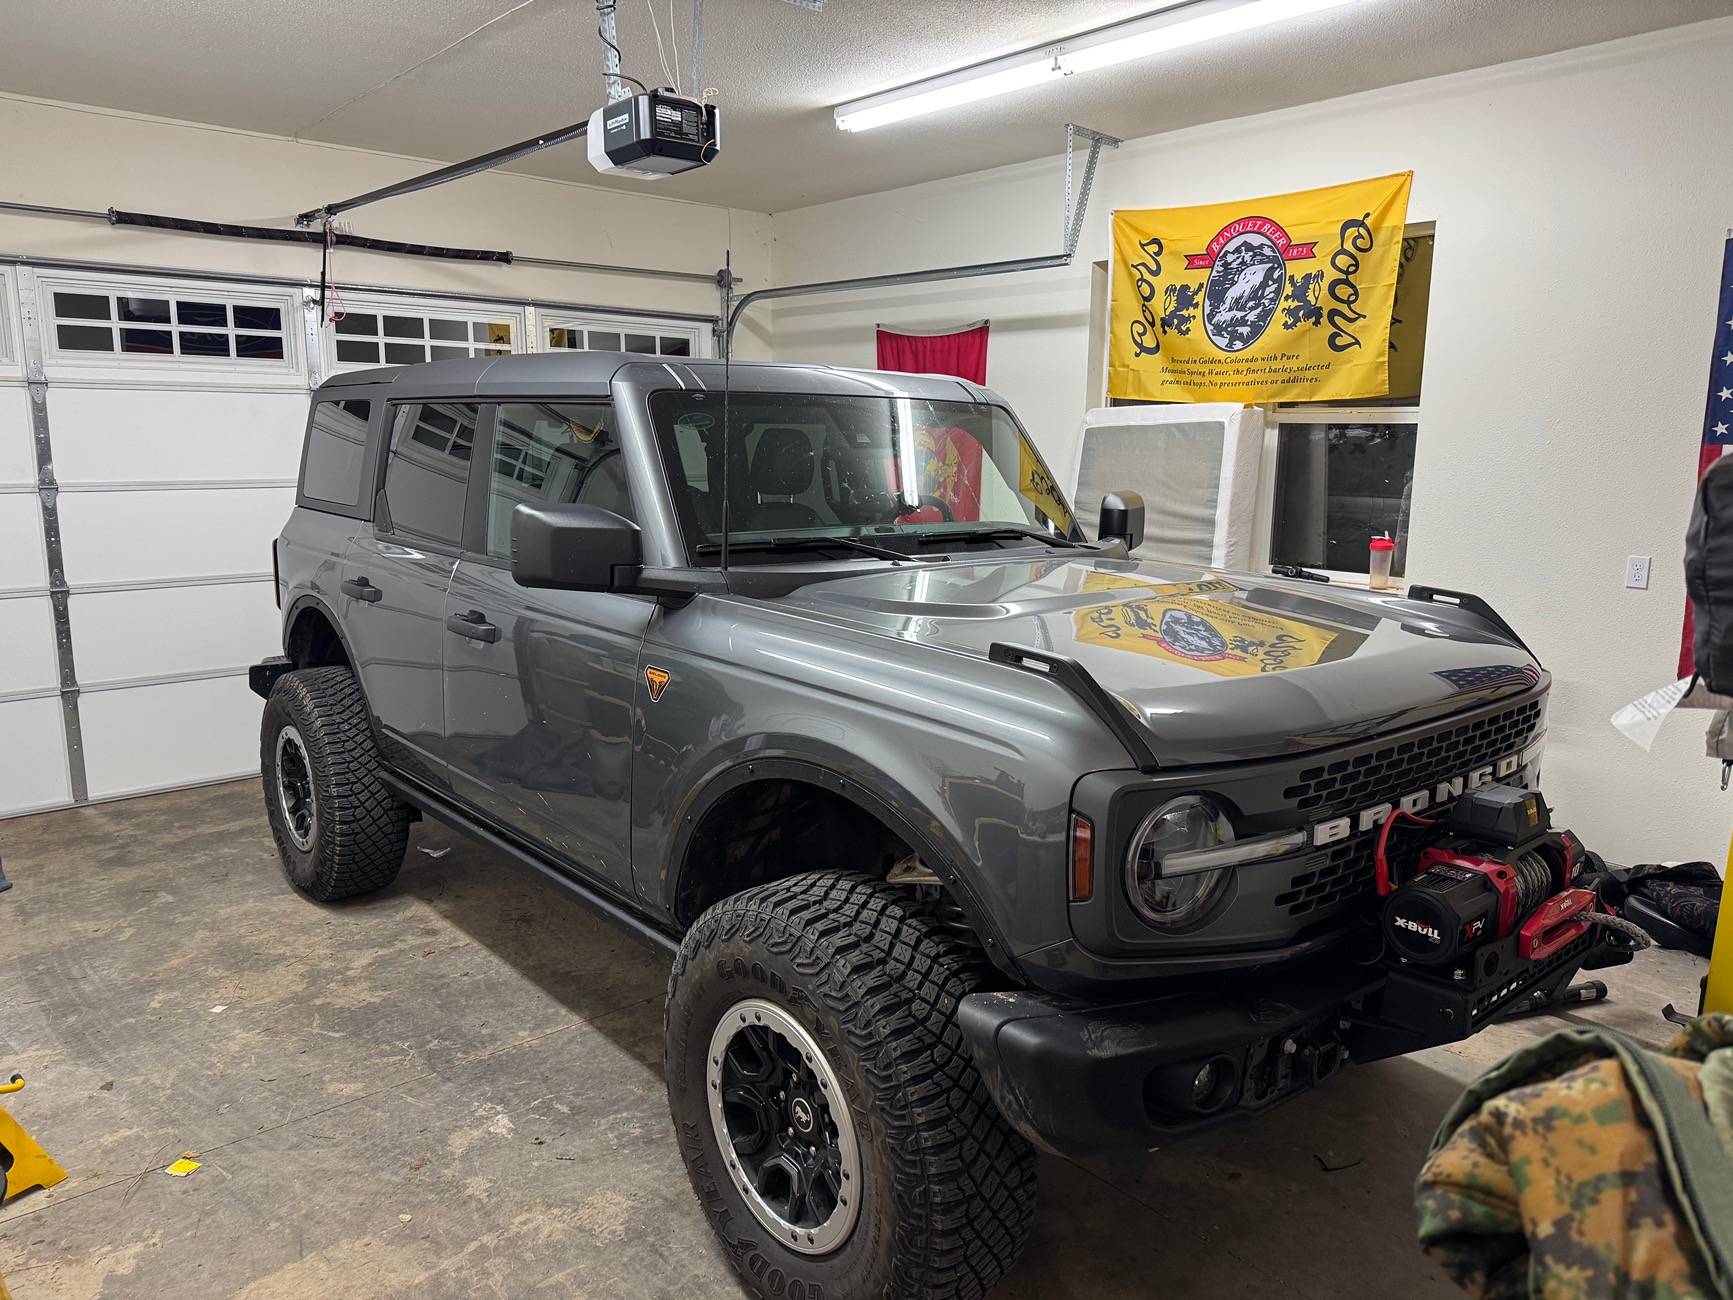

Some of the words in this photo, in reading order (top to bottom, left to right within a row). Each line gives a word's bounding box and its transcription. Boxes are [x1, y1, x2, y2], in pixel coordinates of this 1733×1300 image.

[1211, 220, 1262, 253] BANQUET
[1260, 223, 1287, 247] BEER
[1288, 246, 1307, 257] 1873
[1193, 258, 1210, 266] Since
[1327, 211, 1374, 353] Coors
[1130, 237, 1164, 358] Coors
[1260, 352, 1278, 362] with
[1279, 352, 1300, 361] Pure
[1207, 367, 1231, 377] Water,
[1232, 367, 1244, 376] the
[1244, 366, 1266, 377] finest
[1218, 378, 1270, 389] preservatives
[1280, 375, 1321, 385] additives.
[1313, 753, 1519, 847] BRONCO
[1394, 915, 1442, 940] X-BULL
